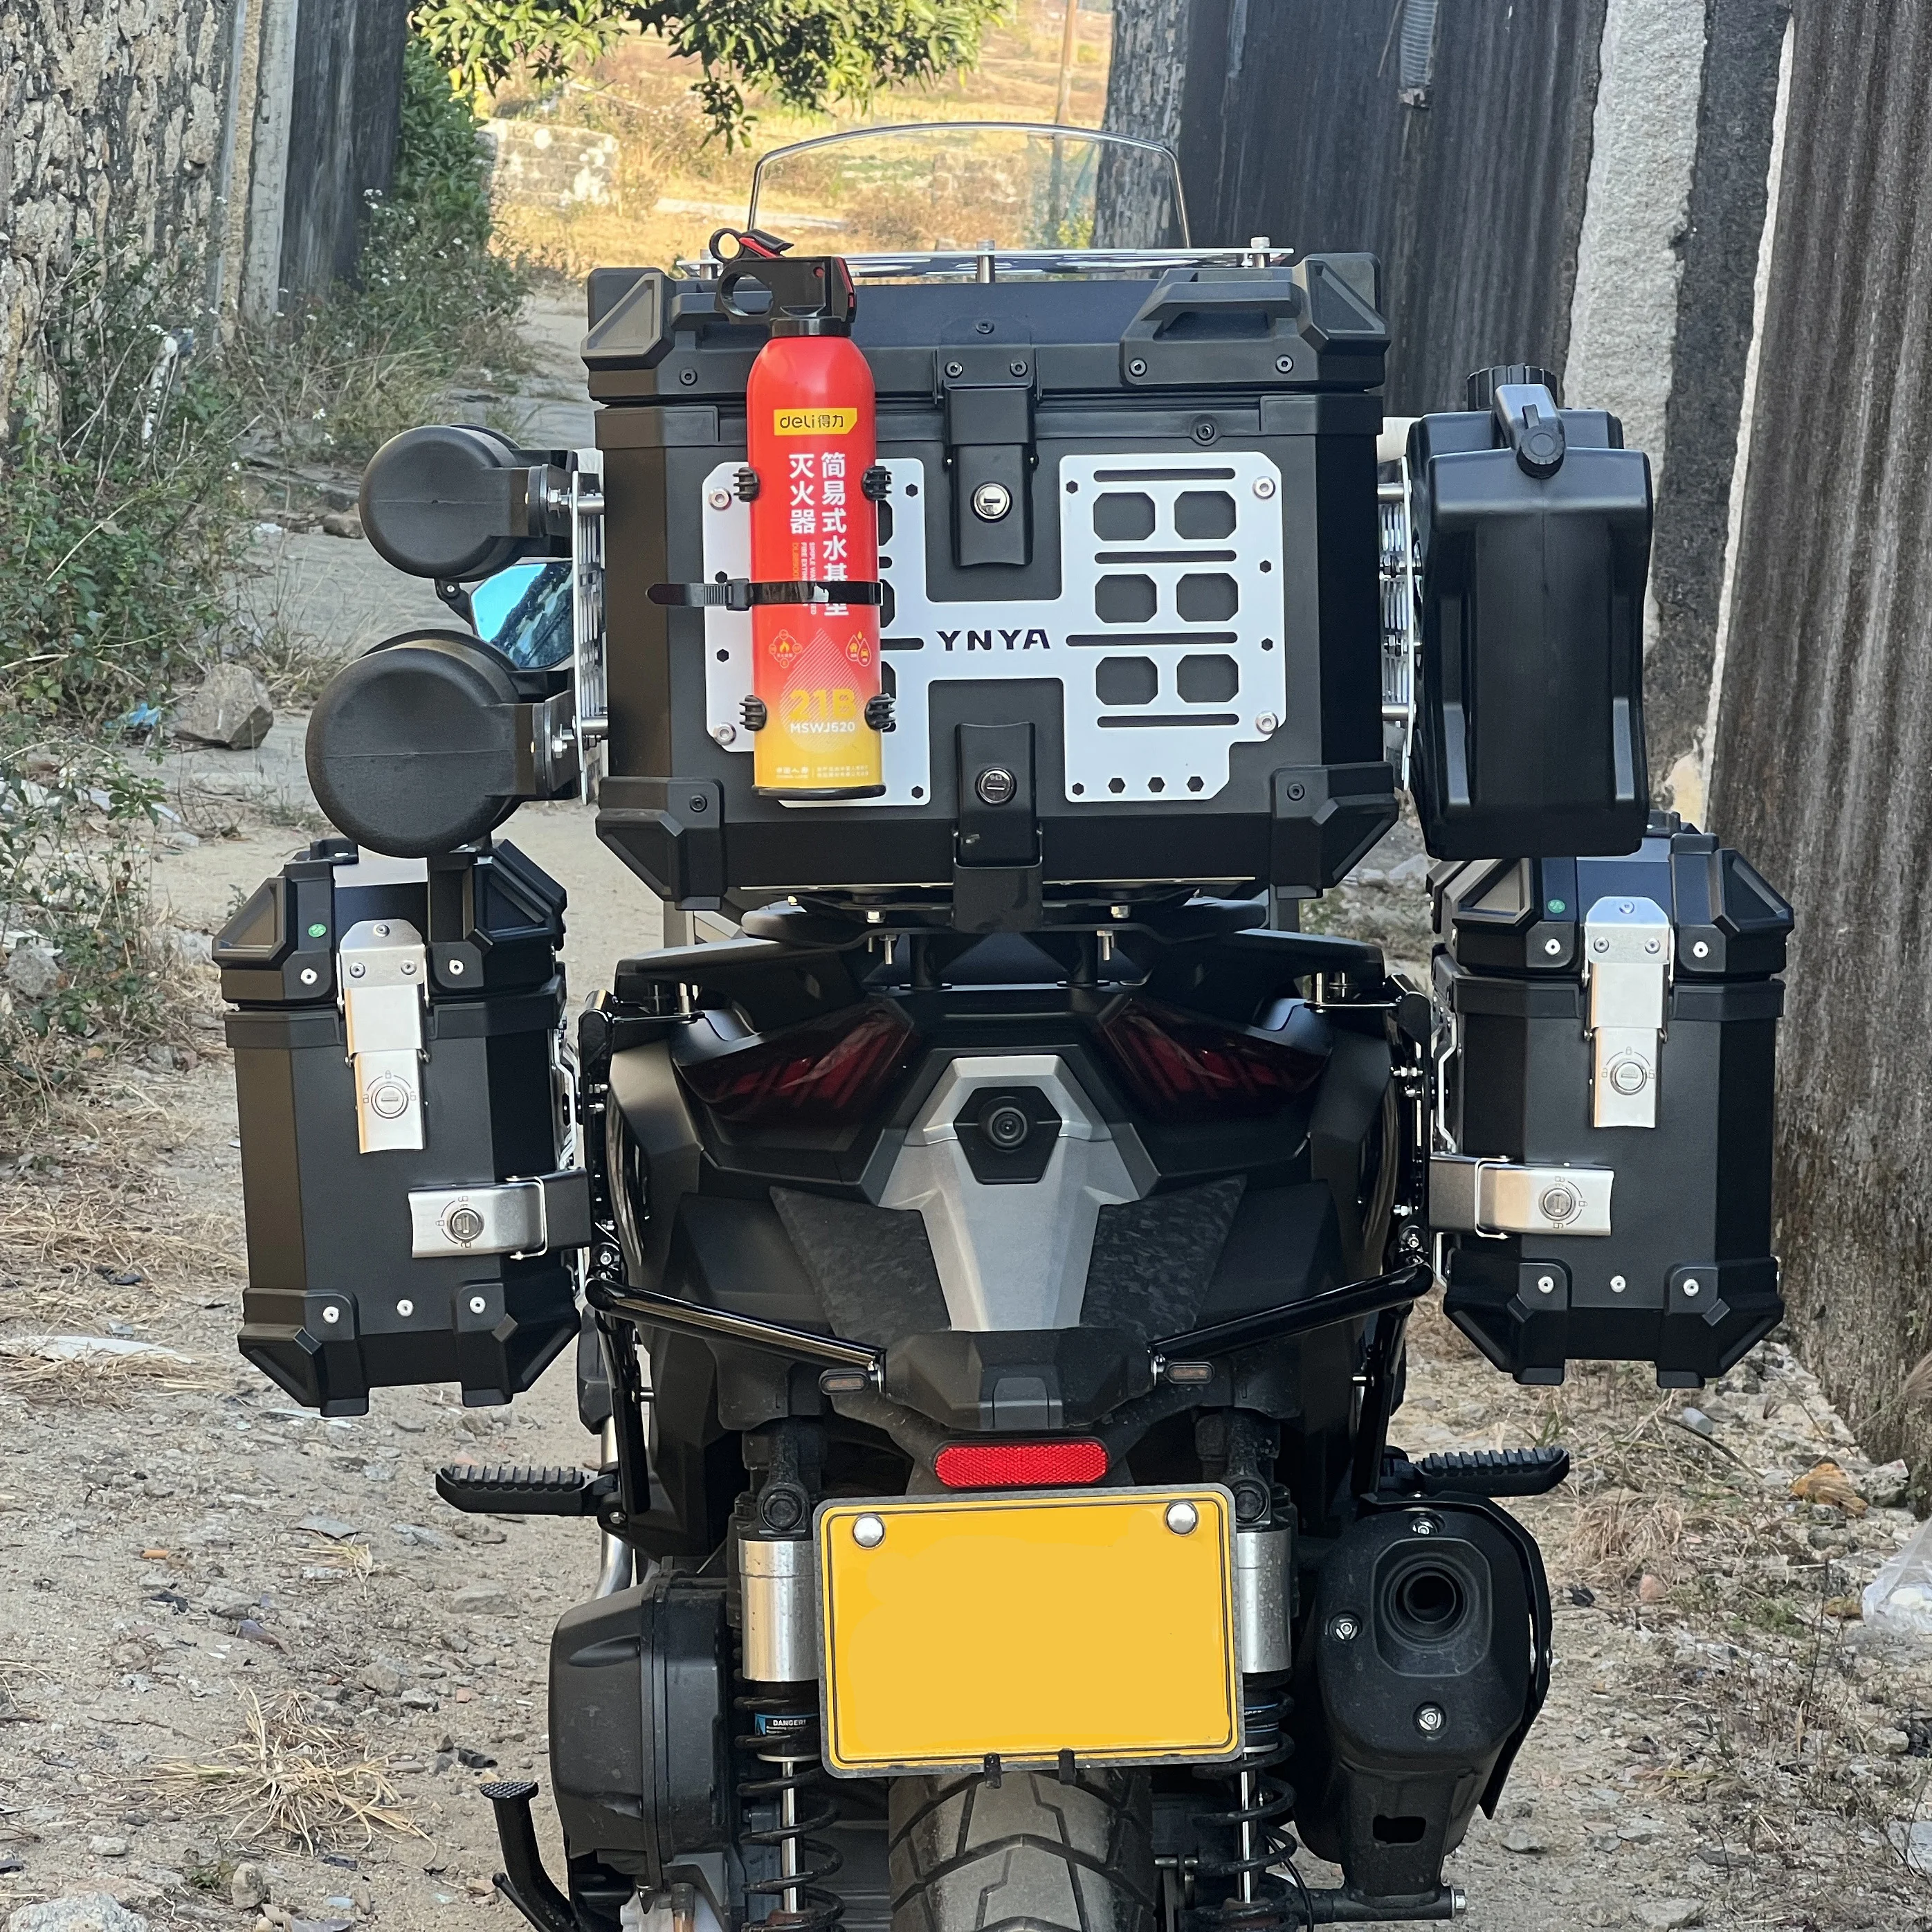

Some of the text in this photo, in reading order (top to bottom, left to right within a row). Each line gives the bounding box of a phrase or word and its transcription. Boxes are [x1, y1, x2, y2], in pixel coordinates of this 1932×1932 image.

[788, 453, 816, 534] 灭火器
[936, 629, 1050, 651] YNYA
[788, 688, 857, 720] 21B
[790, 721, 855, 733] MSWJ620
